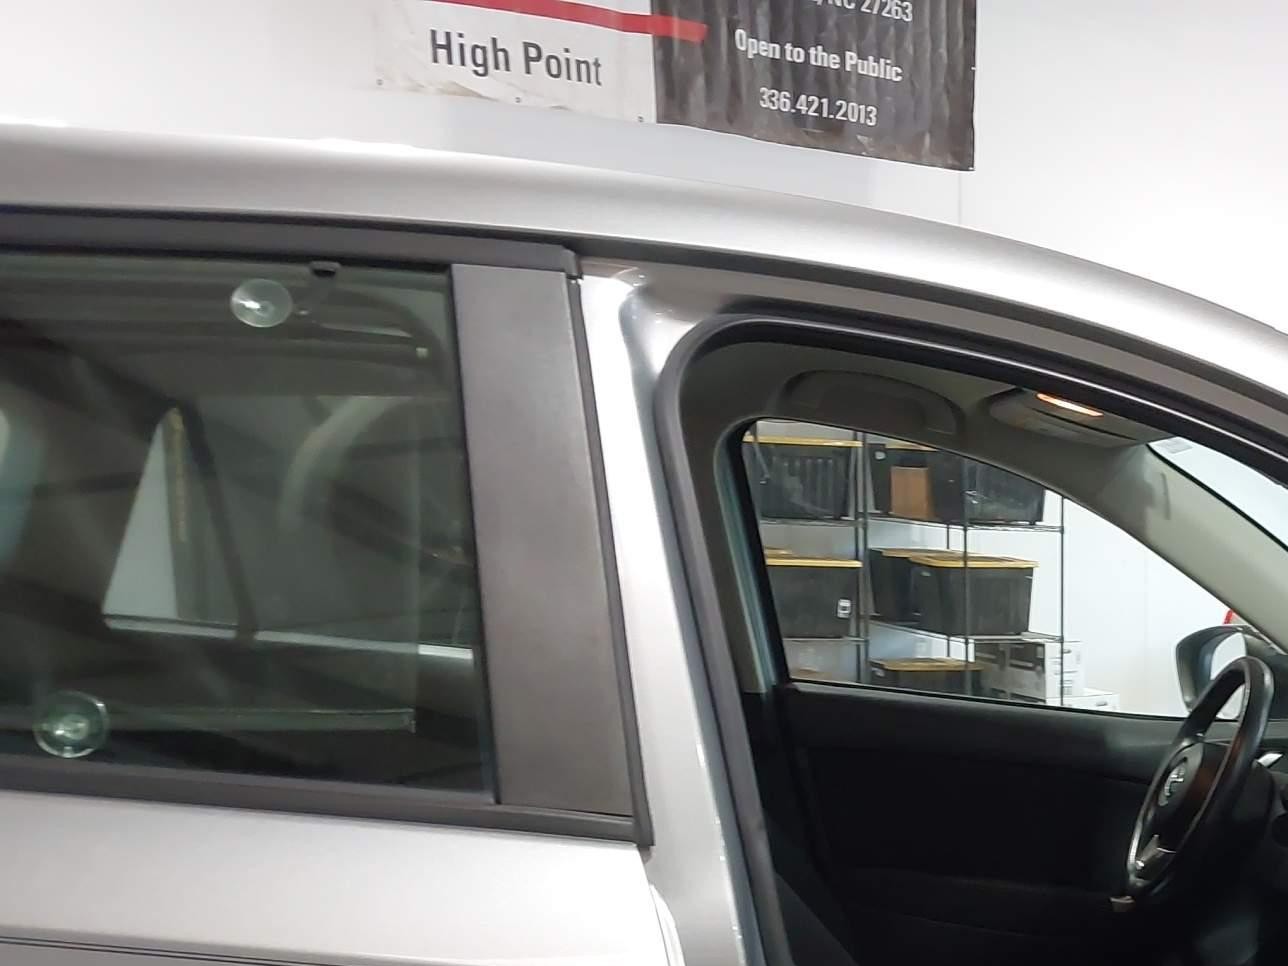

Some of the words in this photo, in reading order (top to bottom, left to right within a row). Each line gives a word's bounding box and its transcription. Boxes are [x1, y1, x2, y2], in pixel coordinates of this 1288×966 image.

[859, 0, 913, 22] 27263
[430, 29, 511, 77] High
[522, 41, 602, 86] Point
[734, 28, 781, 59] Open
[784, 42, 805, 63] to
[808, 45, 841, 70] the
[844, 50, 903, 82] Public
[759, 87, 878, 127] 336.421.2013
